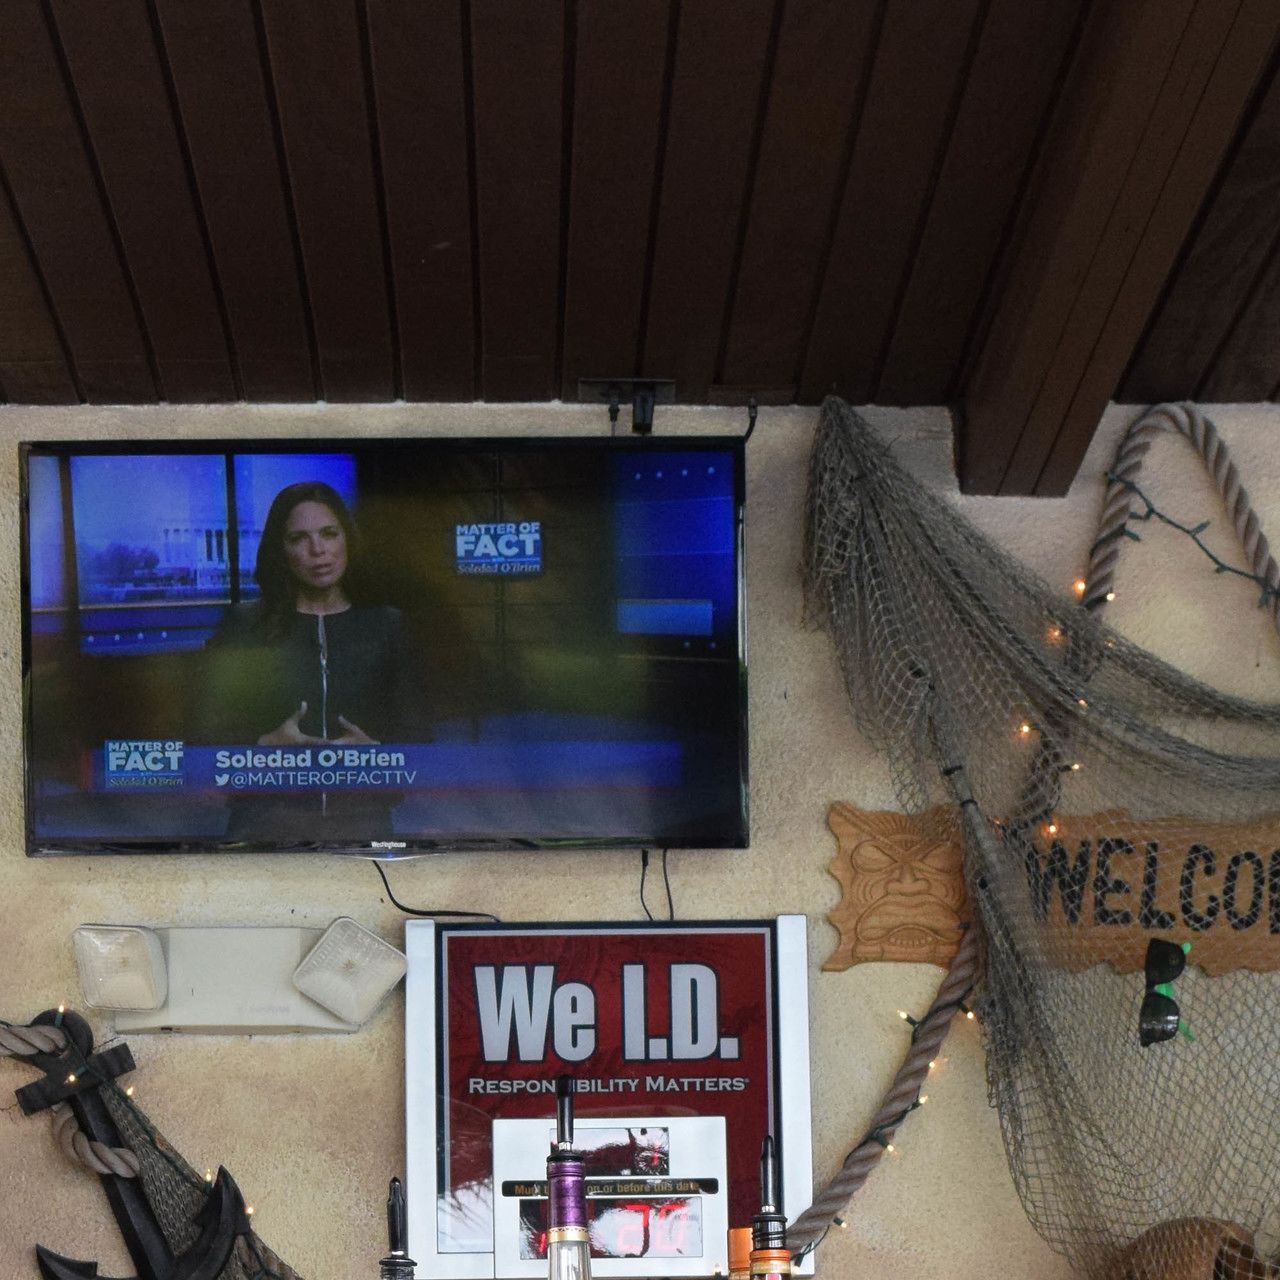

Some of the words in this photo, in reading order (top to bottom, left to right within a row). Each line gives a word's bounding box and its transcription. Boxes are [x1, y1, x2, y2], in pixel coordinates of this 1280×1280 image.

[456, 524, 516, 535] MATTER
[519, 522, 540, 534] OF
[456, 533, 540, 557] FACT
[108, 742, 163, 751] MATTER
[165, 741, 183, 750] OF
[108, 752, 183, 771] FACT
[216, 750, 311, 768] Soledad
[318, 749, 405, 768] O'Brien
[230, 771, 417, 788] @MATTEROFFACTTV
[473, 963, 597, 1064] We
[622, 963, 740, 1062] I.D.
[644, 1074, 746, 1093] MATTERS
[617, 1183, 650, 1193] before
